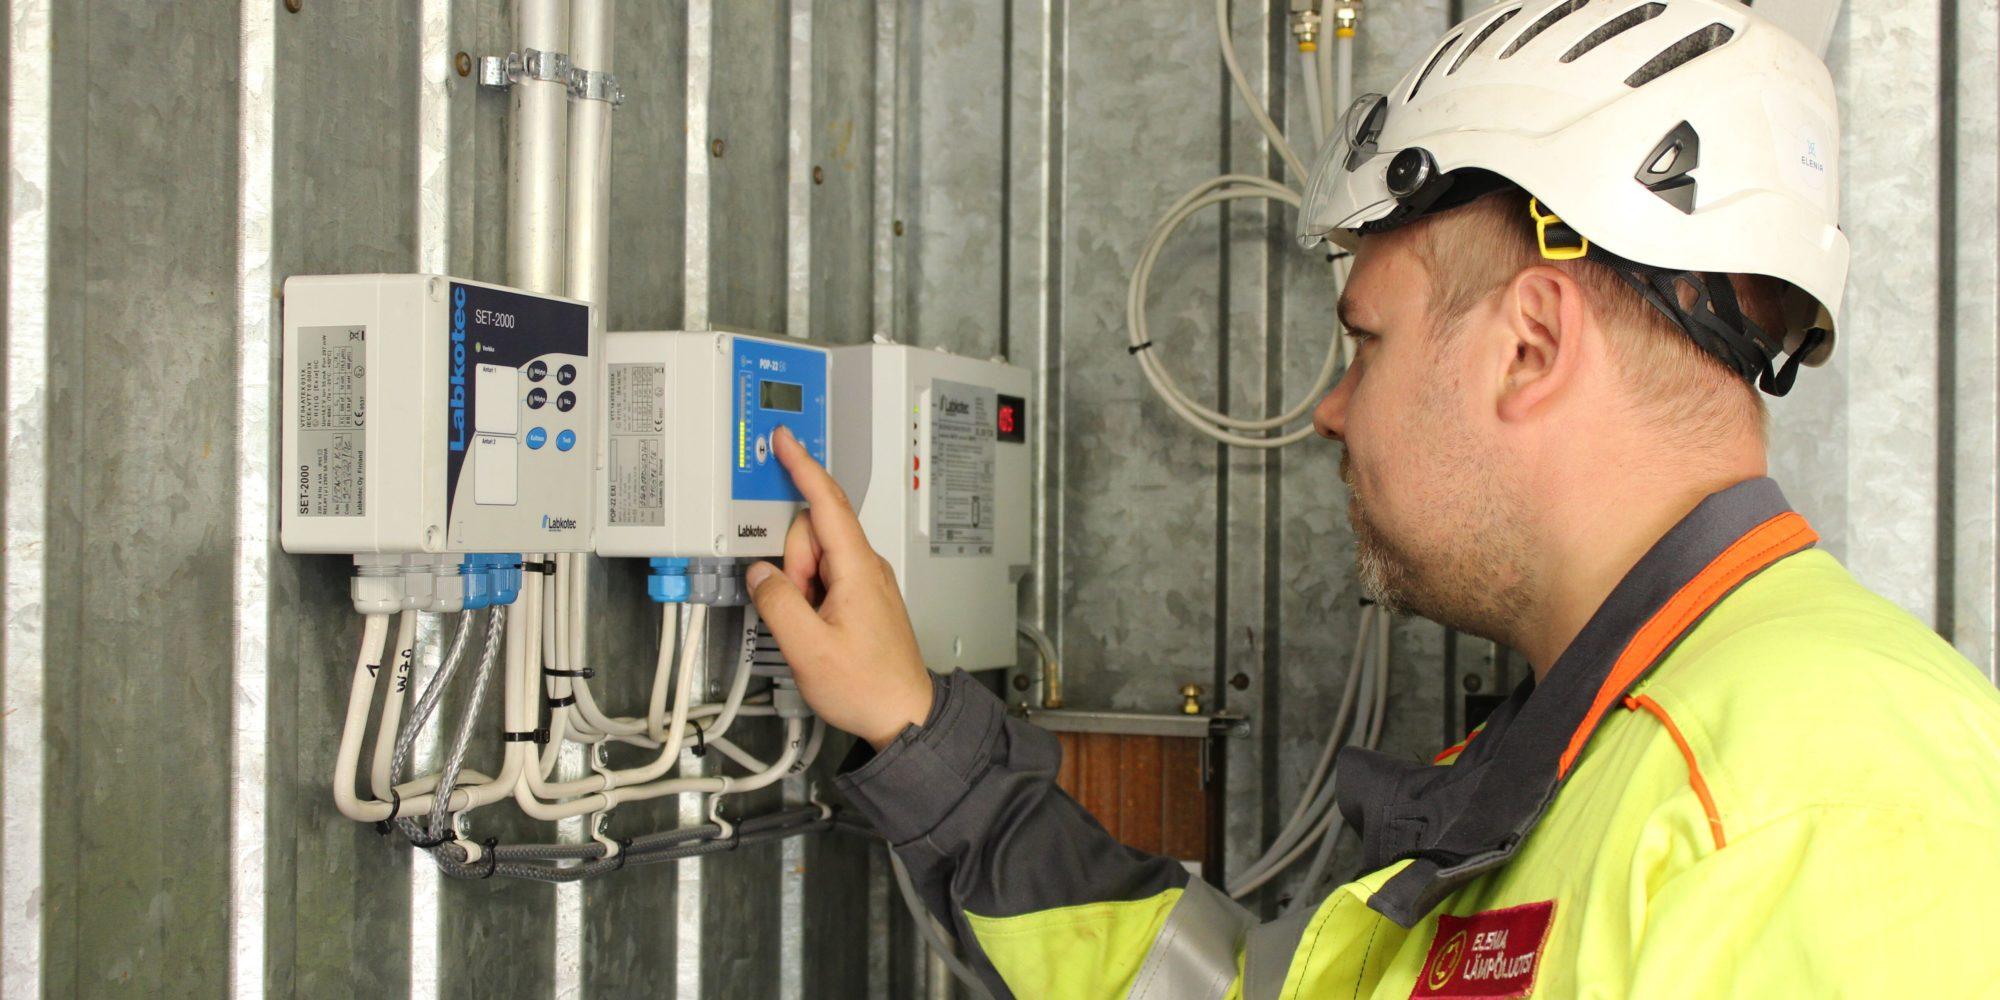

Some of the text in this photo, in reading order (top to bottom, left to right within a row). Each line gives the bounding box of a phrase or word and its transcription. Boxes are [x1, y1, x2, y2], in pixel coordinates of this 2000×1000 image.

[475, 309, 515, 329] SET-2000
[450, 287, 465, 452] Labkotec
[300, 465, 309, 514] SET-2000
[357, 476, 363, 486] Oy
[548, 517, 577, 530] Labkotec
[738, 524, 768, 538] Labkotec
[396, 648, 412, 693] W70
